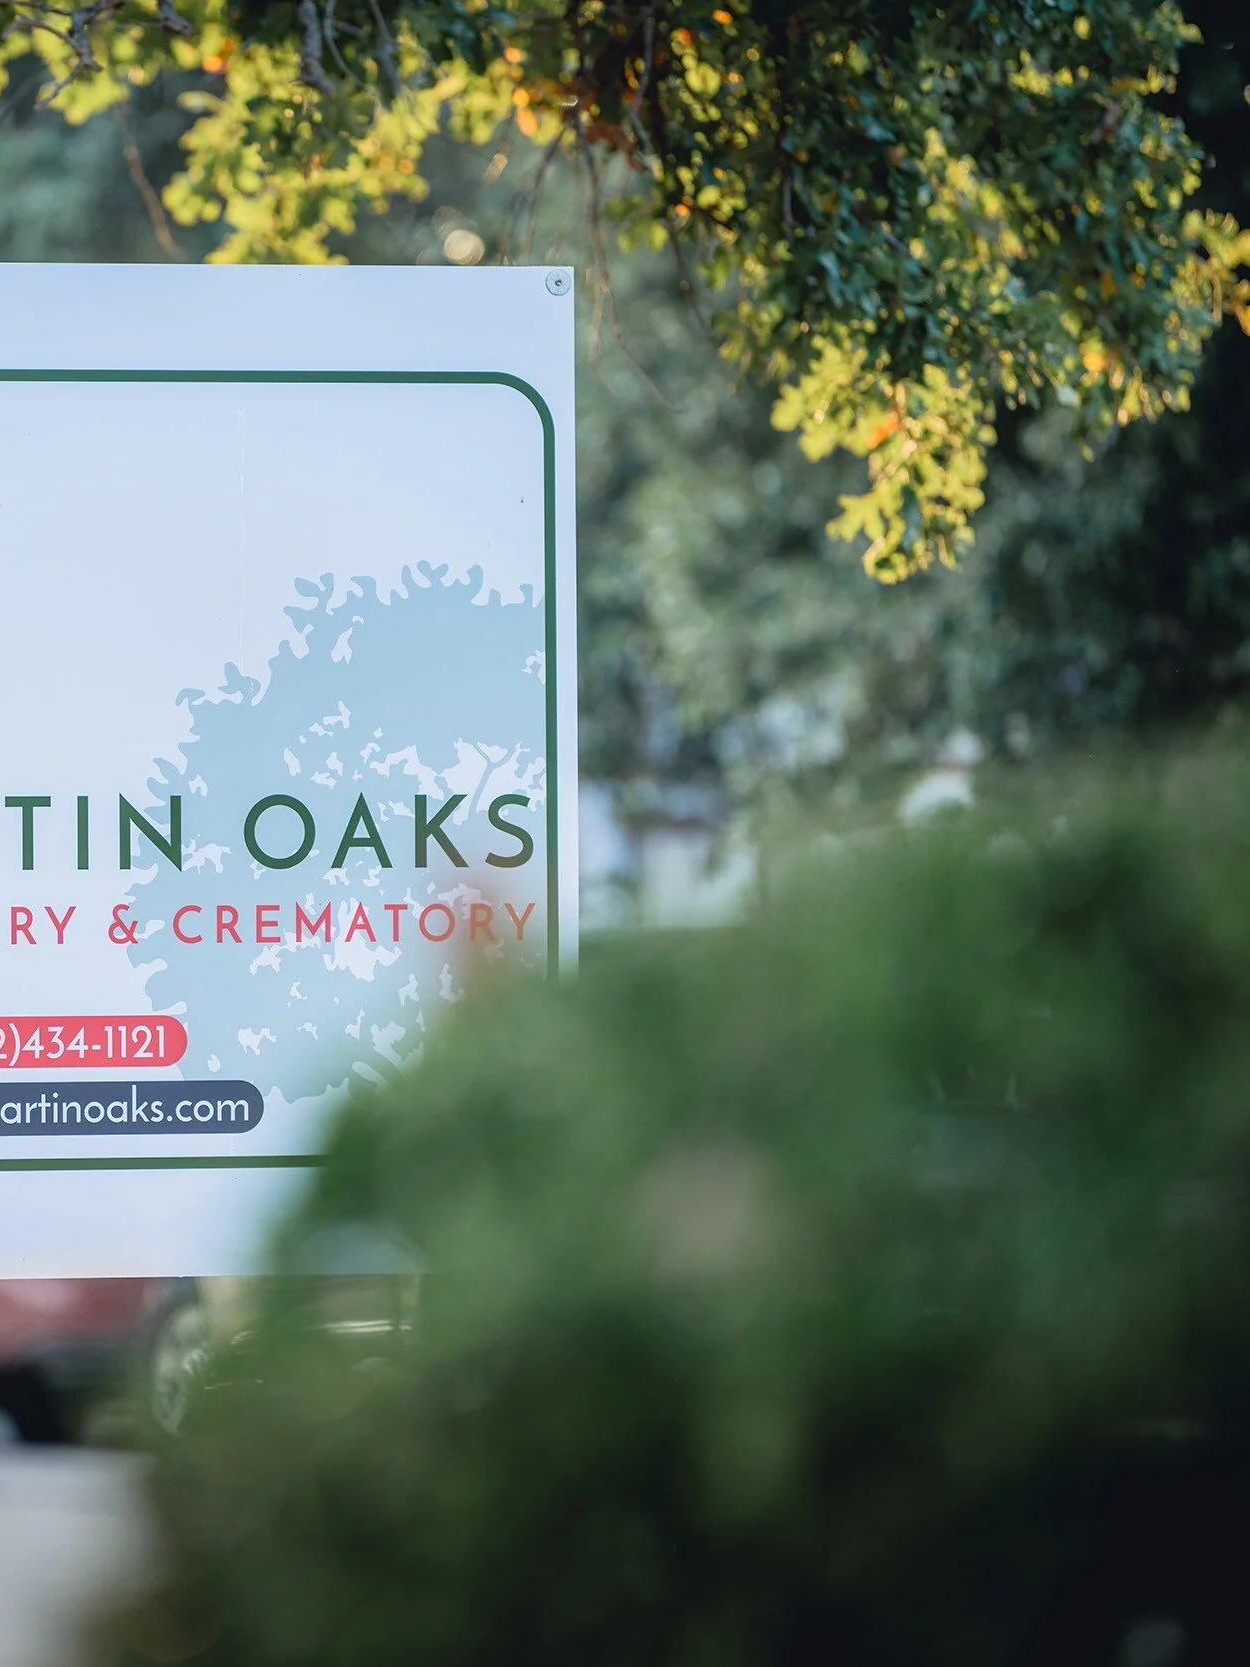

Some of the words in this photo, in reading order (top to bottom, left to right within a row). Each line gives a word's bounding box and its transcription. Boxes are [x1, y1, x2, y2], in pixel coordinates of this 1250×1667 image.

[242, 791, 536, 871] OAKS
[107, 904, 141, 946] &
[171, 901, 538, 945] CREMATORY
